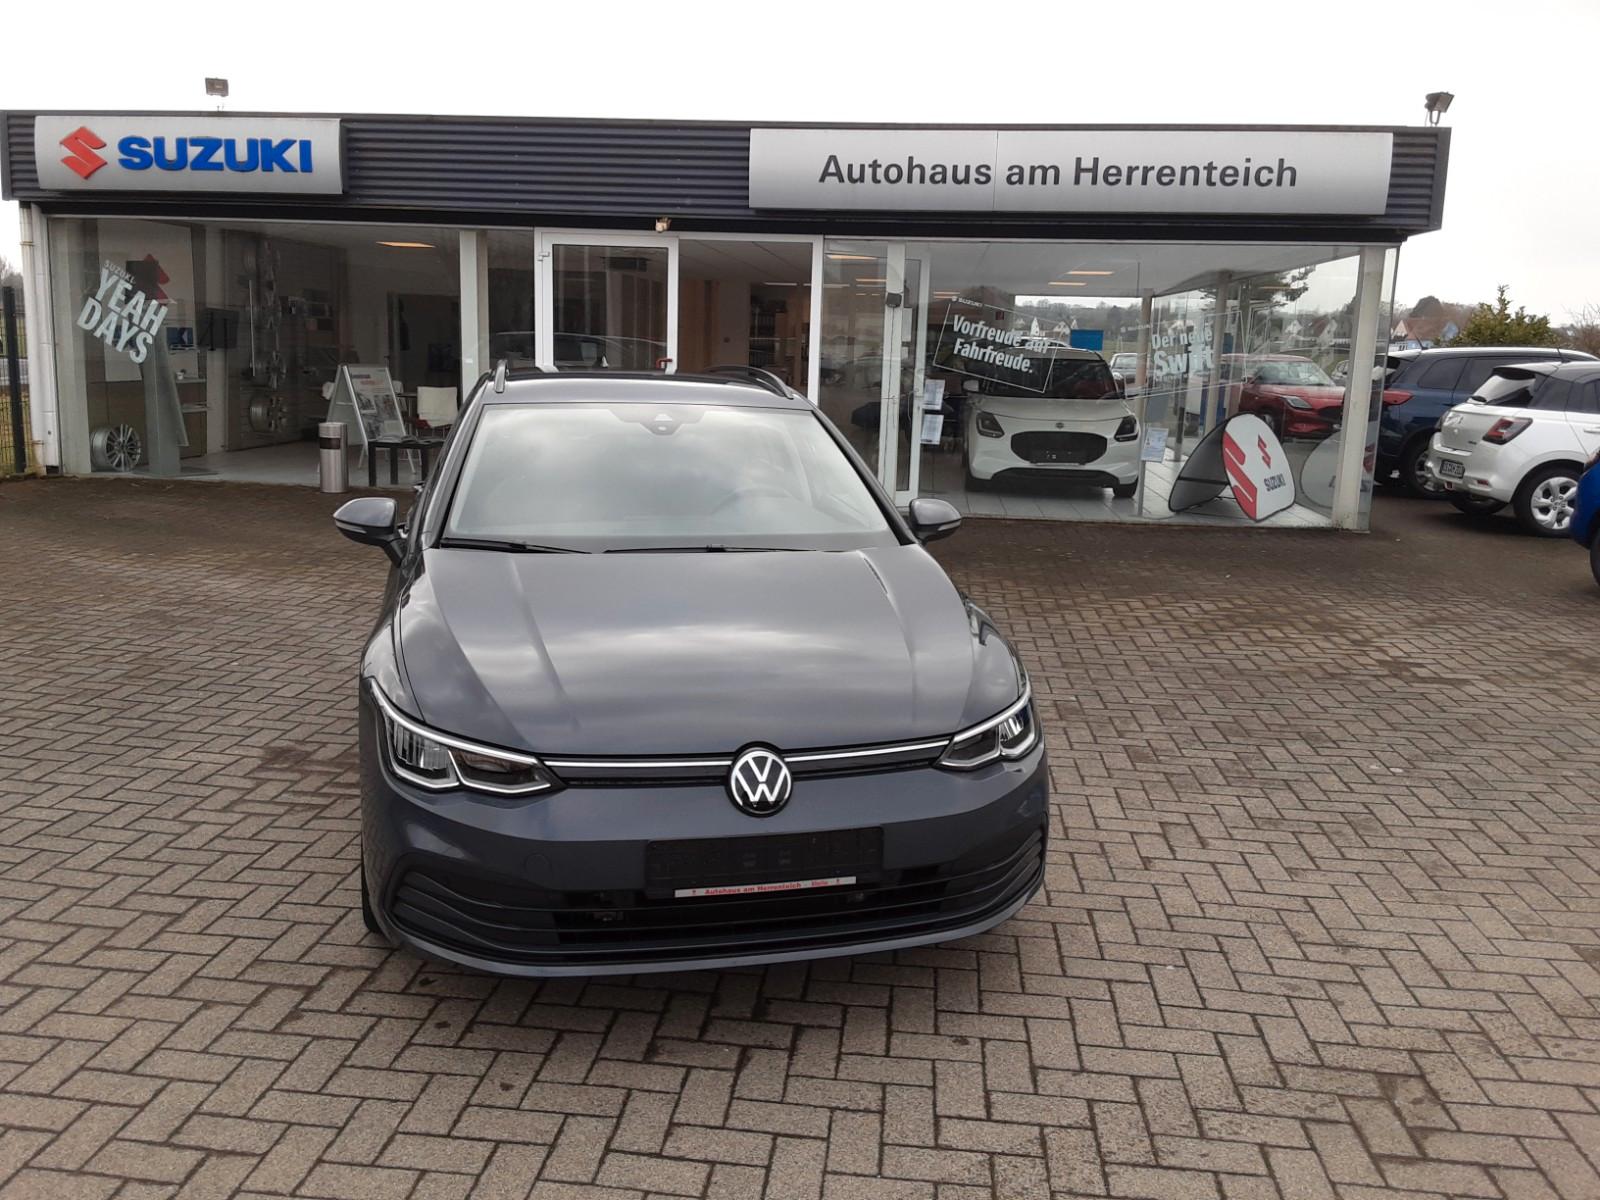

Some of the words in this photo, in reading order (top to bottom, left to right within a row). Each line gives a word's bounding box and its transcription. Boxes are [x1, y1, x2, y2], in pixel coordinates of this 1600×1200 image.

[118, 135, 313, 173] SUZUKI
[818, 154, 992, 185] Autohaus
[1005, 163, 1061, 185] am
[1073, 157, 1298, 187] Herrenteich
[95, 267, 168, 336] YEAH
[77, 297, 153, 363] DAYS
[953, 314, 1024, 347] Vorfreude
[1025, 337, 1051, 354] auf
[1152, 333, 1178, 349] Der
[953, 338, 1033, 373] Fahrfreude.
[1153, 345, 1214, 377] Swift
[1263, 473, 1286, 492] SUZUKI
[704, 886, 741, 895] Autohaus
[743, 885, 755, 893] am
